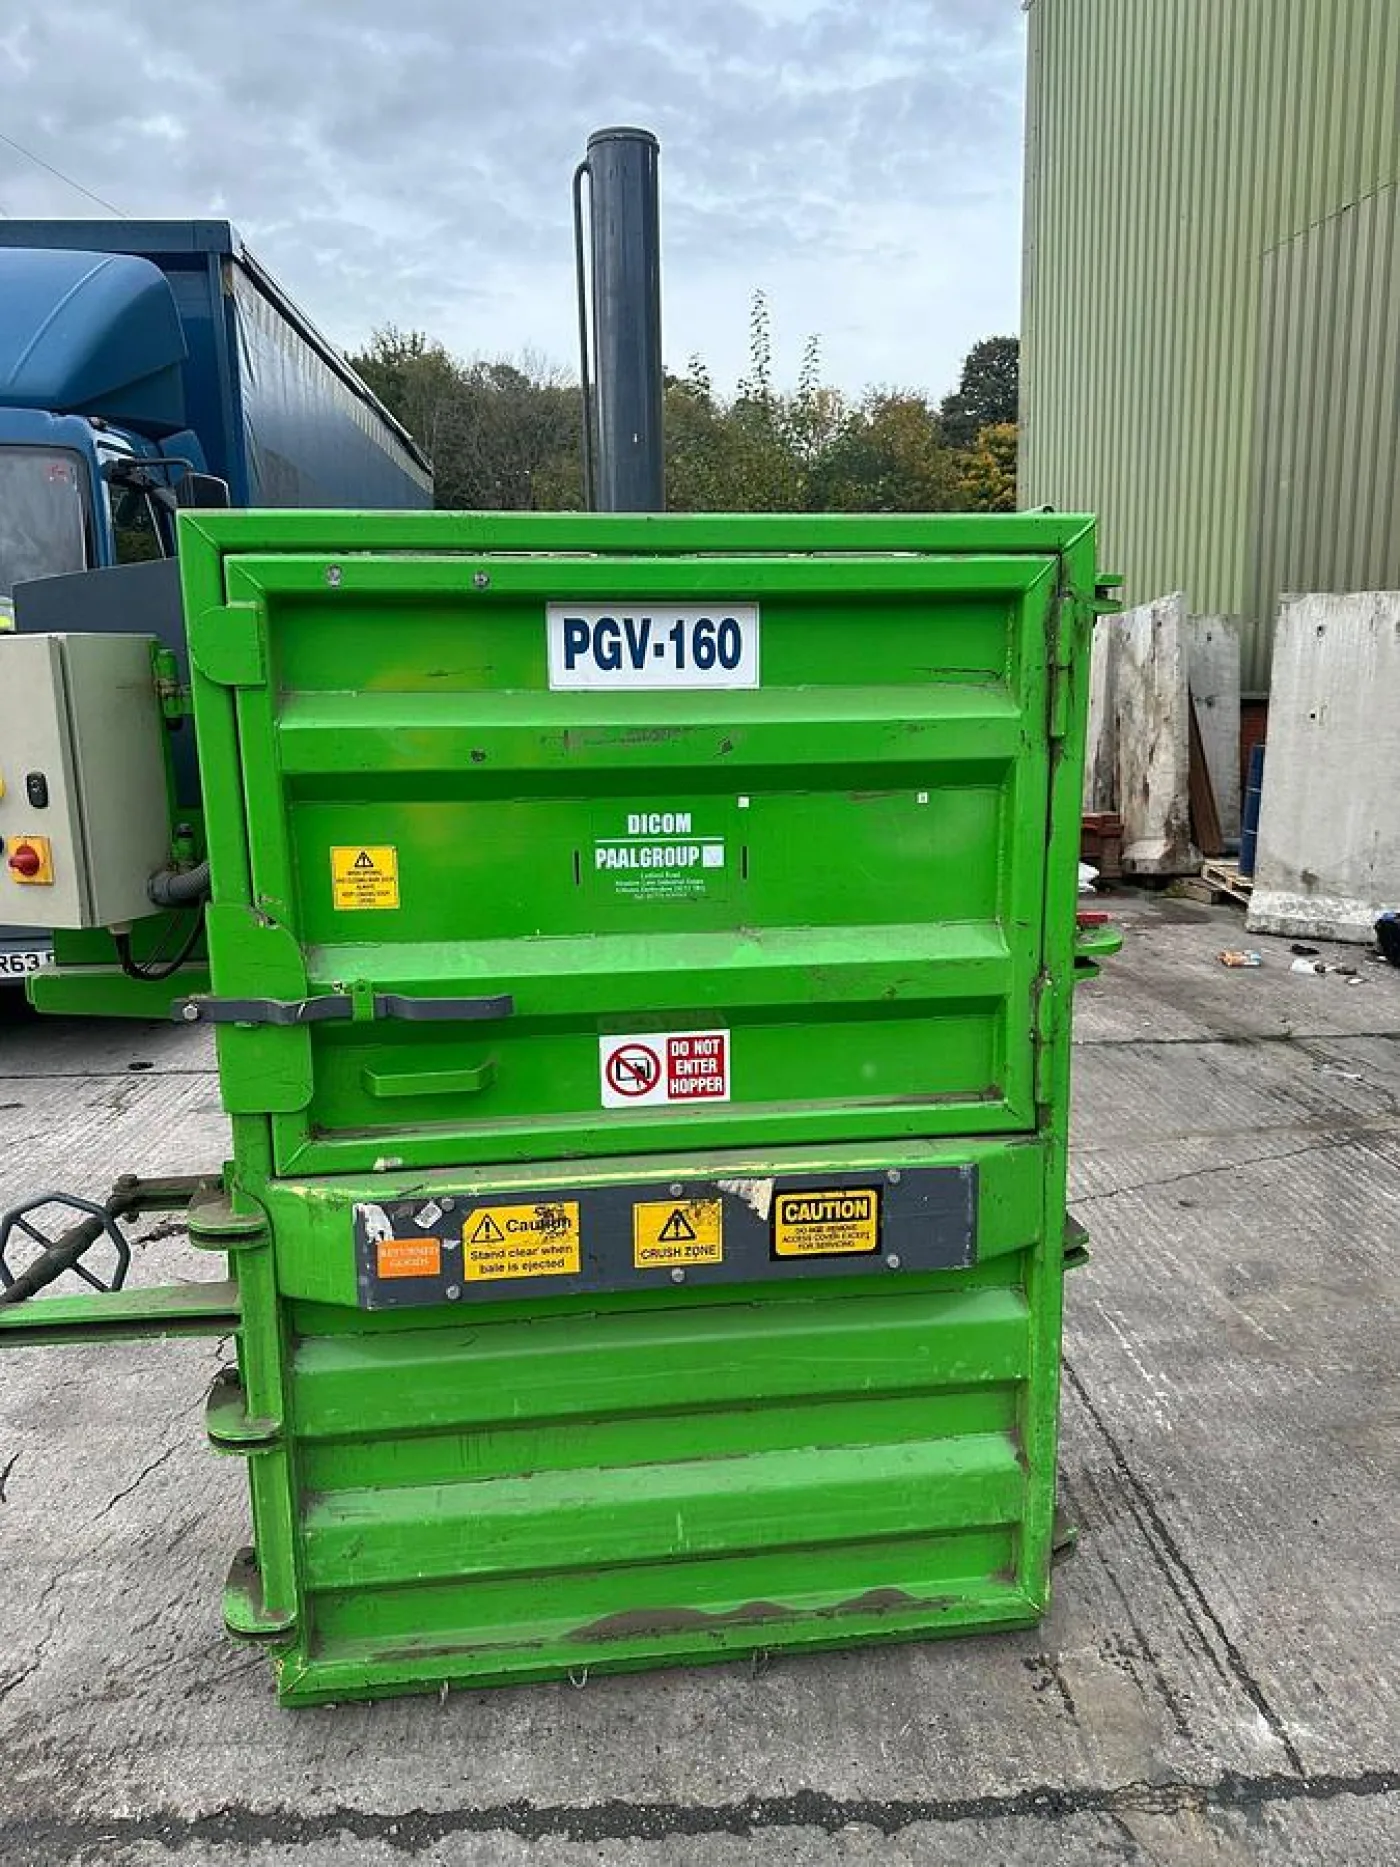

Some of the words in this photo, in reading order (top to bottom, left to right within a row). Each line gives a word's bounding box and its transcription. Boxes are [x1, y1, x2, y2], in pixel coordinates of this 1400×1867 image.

[563, 617, 742, 671] PGV-160
[628, 812, 691, 834] DICOM
[595, 846, 699, 869] PAALGROUP
[671, 1041, 689, 1057] DO
[694, 1039, 721, 1056] NOT
[675, 1058, 718, 1076] ENTER
[670, 1076, 723, 1094] HOPPER
[785, 1199, 869, 1222] CAUTION
[470, 1248, 505, 1262] Stand
[507, 1247, 538, 1258] clear
[540, 1245, 573, 1255] when
[639, 1246, 681, 1259] CRUSH
[684, 1243, 717, 1257] ZONE
[480, 1263, 505, 1274] bale
[507, 1262, 519, 1271] is
[522, 1257, 565, 1272] ejected
